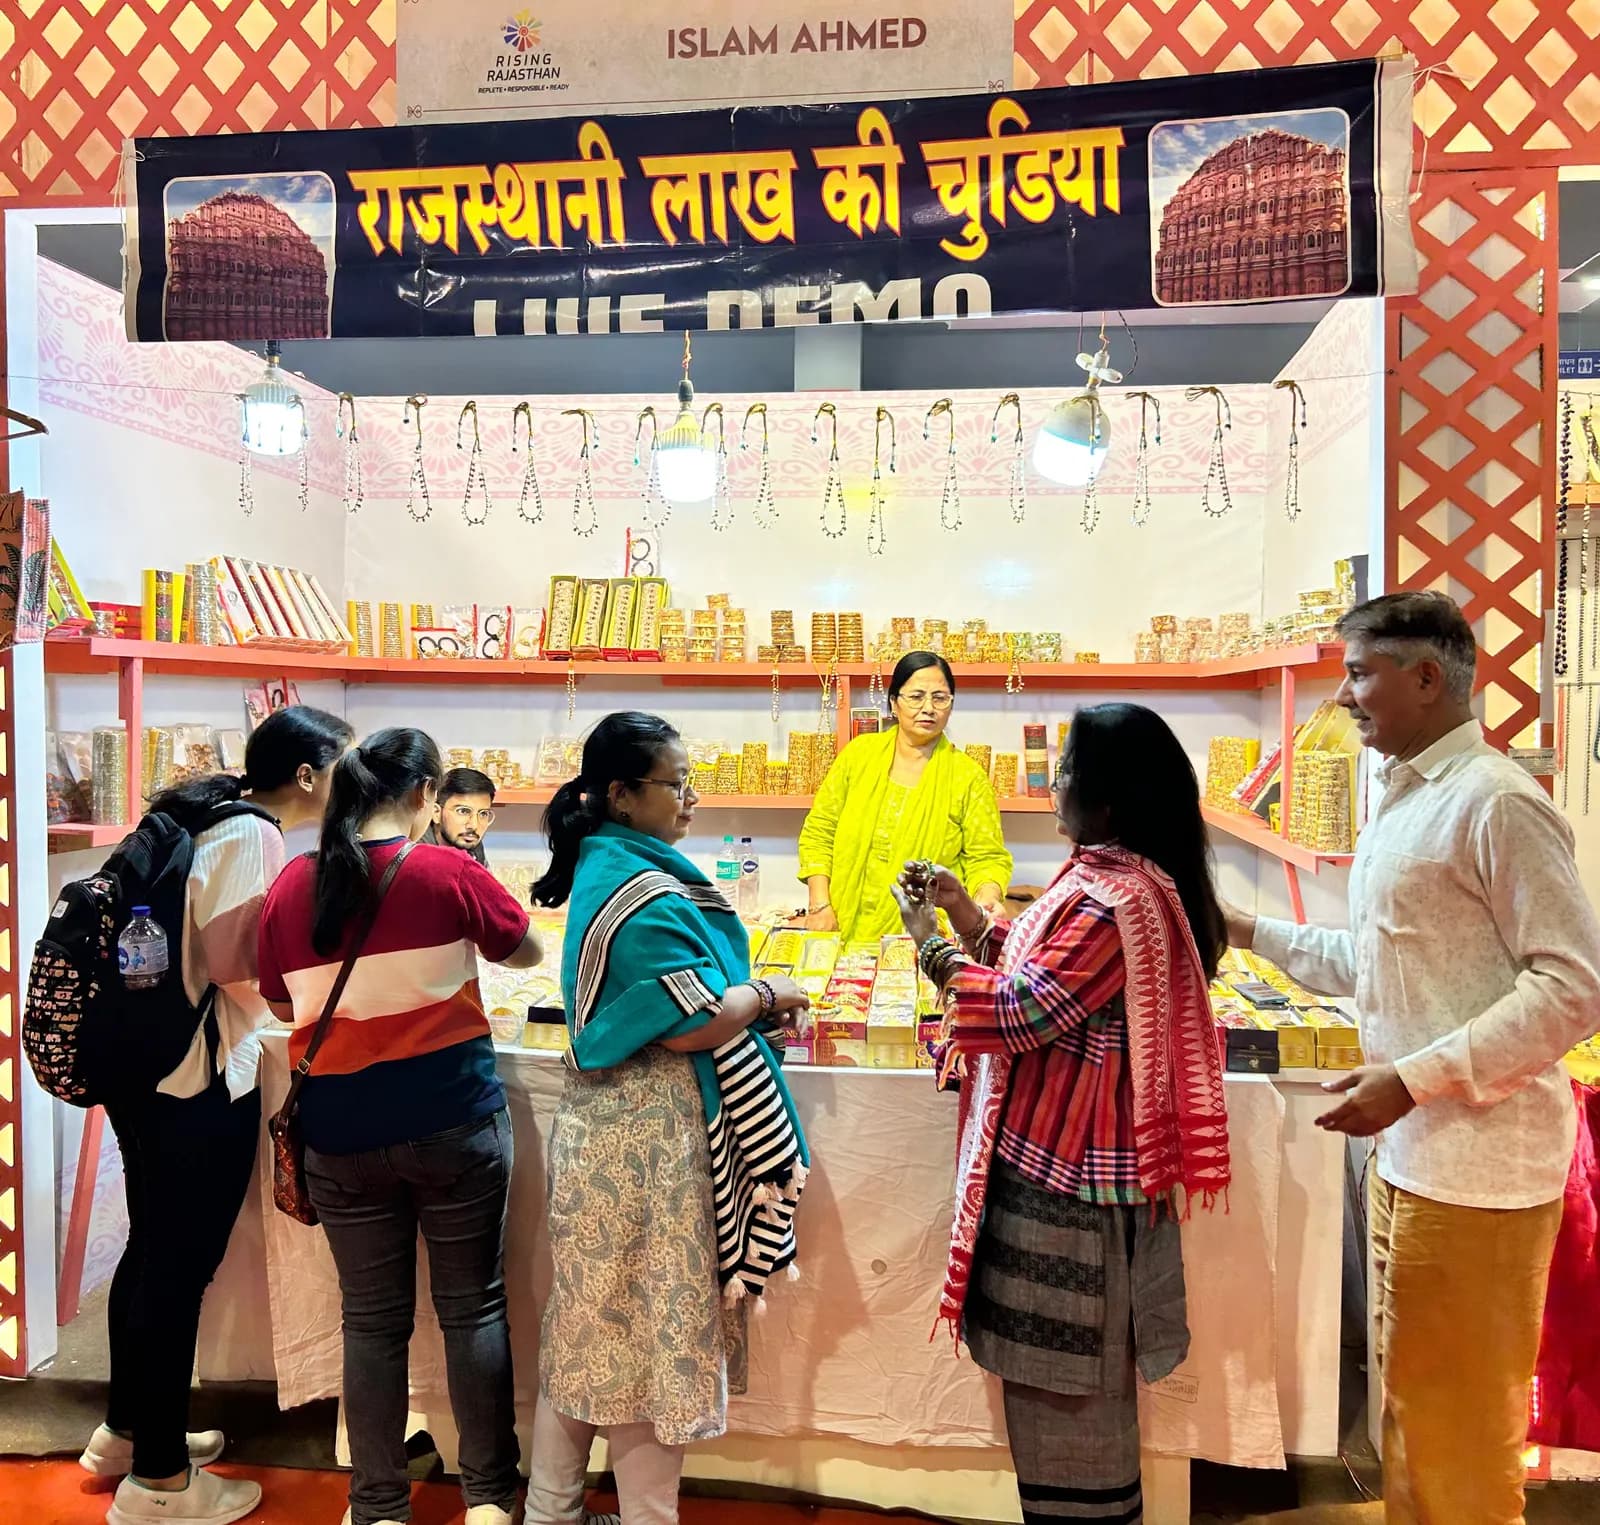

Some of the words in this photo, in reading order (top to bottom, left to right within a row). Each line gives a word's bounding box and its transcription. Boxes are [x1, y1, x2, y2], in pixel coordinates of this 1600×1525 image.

[667, 23, 778, 59] ISLAM
[790, 17, 927, 53] AHMED
[496, 53, 552, 67] RISING
[487, 67, 560, 82] RAJASTHAN
[478, 86, 503, 94] REPLETE
[507, 85, 545, 93] RESPONSIBLE
[549, 83, 569, 91] READY
[346, 120, 626, 257] राजस्थानी
[638, 149, 799, 248] लाख
[811, 106, 906, 240] की
